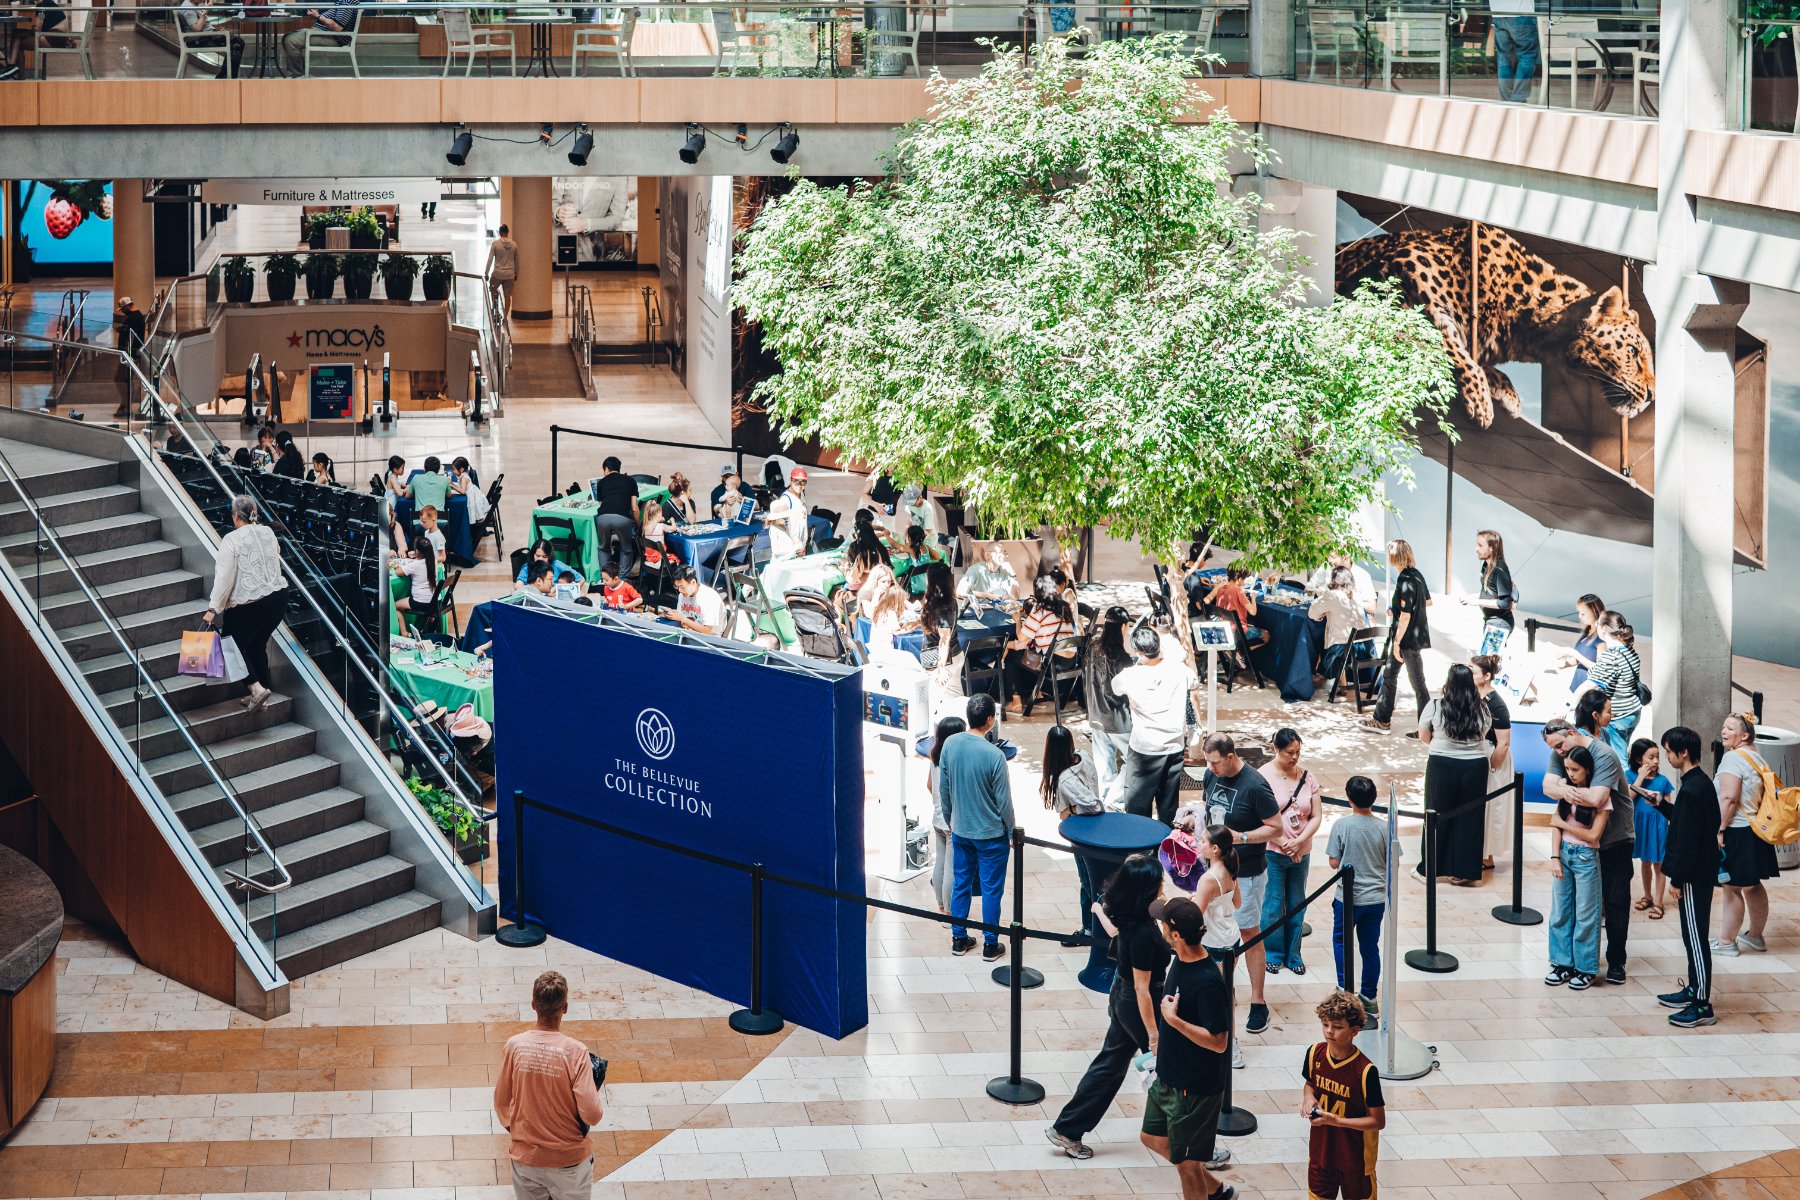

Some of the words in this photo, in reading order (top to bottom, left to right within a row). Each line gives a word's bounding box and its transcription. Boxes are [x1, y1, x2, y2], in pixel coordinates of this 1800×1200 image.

[263, 189, 315, 201] Furniture
[319, 190, 328, 201] &
[331, 190, 395, 201] Mattresses
[555, 182, 611, 190] INDOCINO
[305, 324, 385, 352] macy's
[615, 758, 637, 775] THE
[642, 766, 701, 793] BELLEVUE
[604, 773, 712, 818] COLLECTION
[1315, 1074, 1350, 1098] YAKIMA
